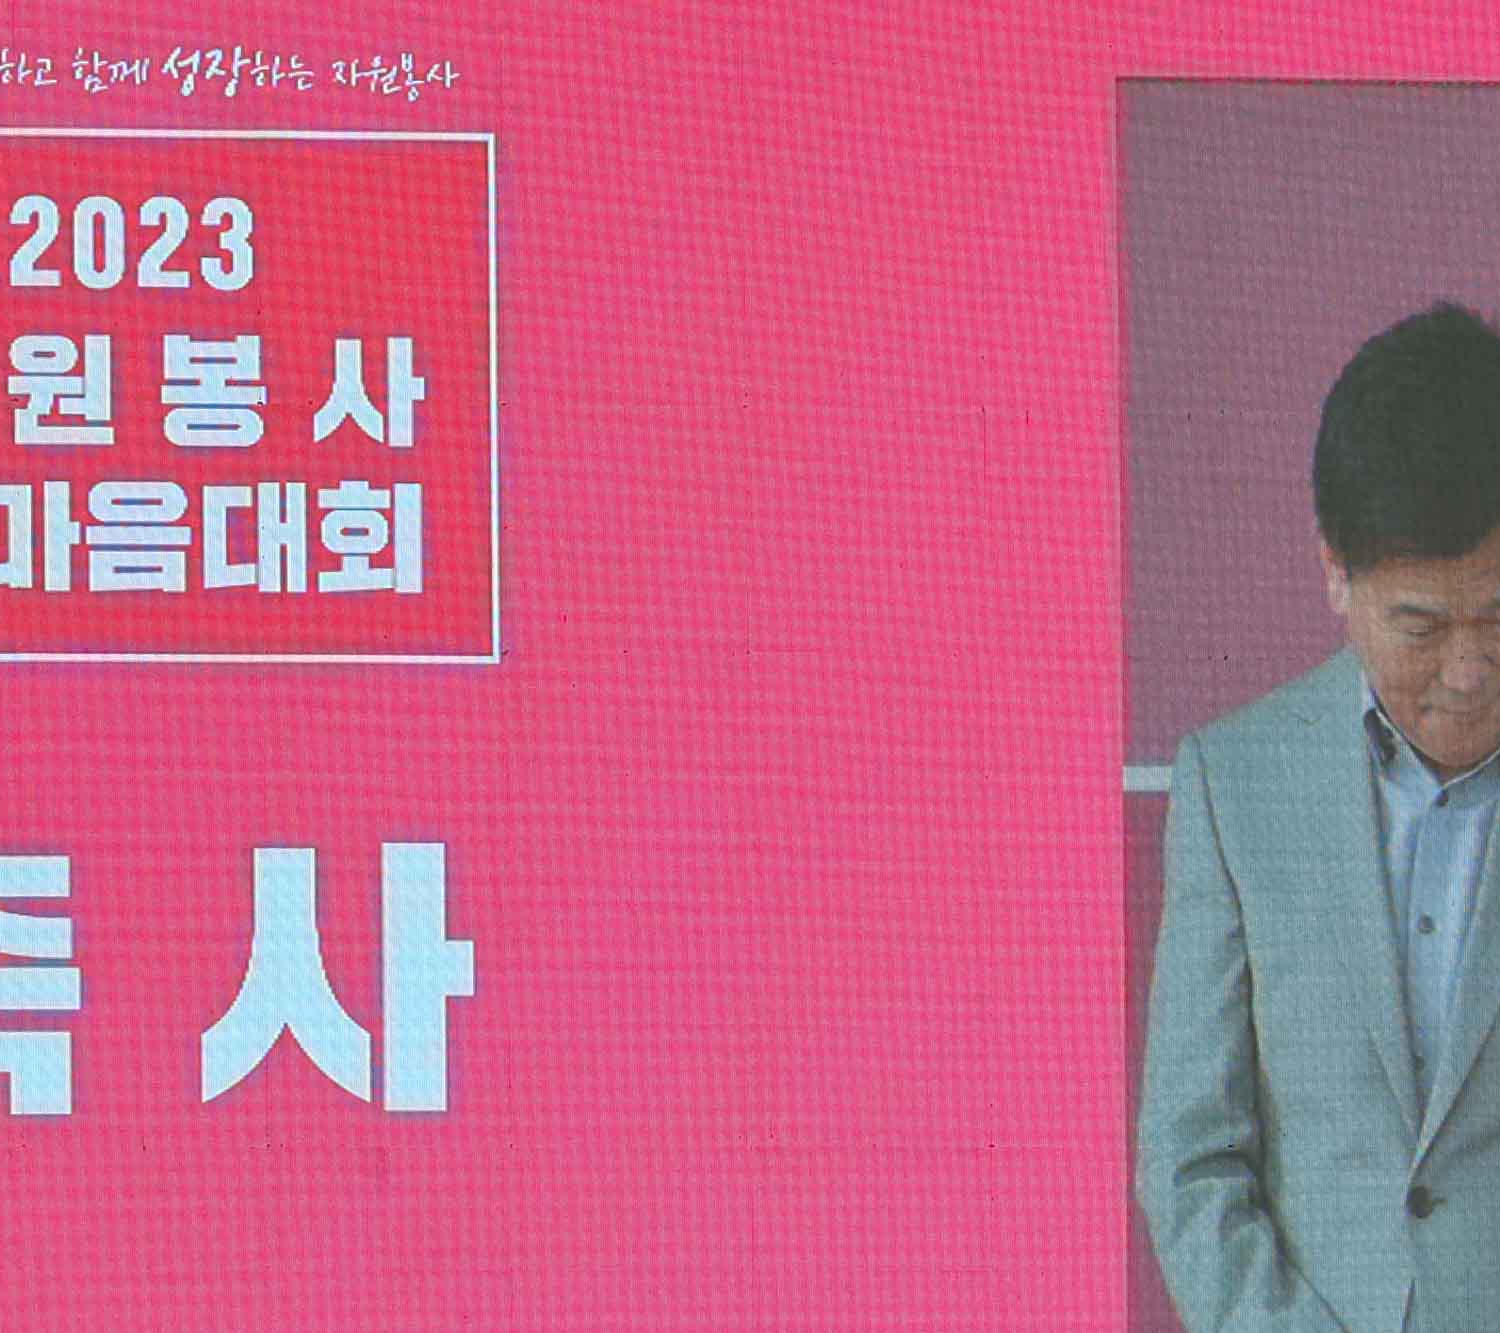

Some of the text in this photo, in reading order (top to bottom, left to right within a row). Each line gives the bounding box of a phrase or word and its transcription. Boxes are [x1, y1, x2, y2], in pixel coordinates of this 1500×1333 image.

[71, 48, 149, 93] 함께
[161, 46, 315, 97] 성장하는
[331, 53, 460, 101] 자원봉사
[8, 194, 256, 291] 2023
